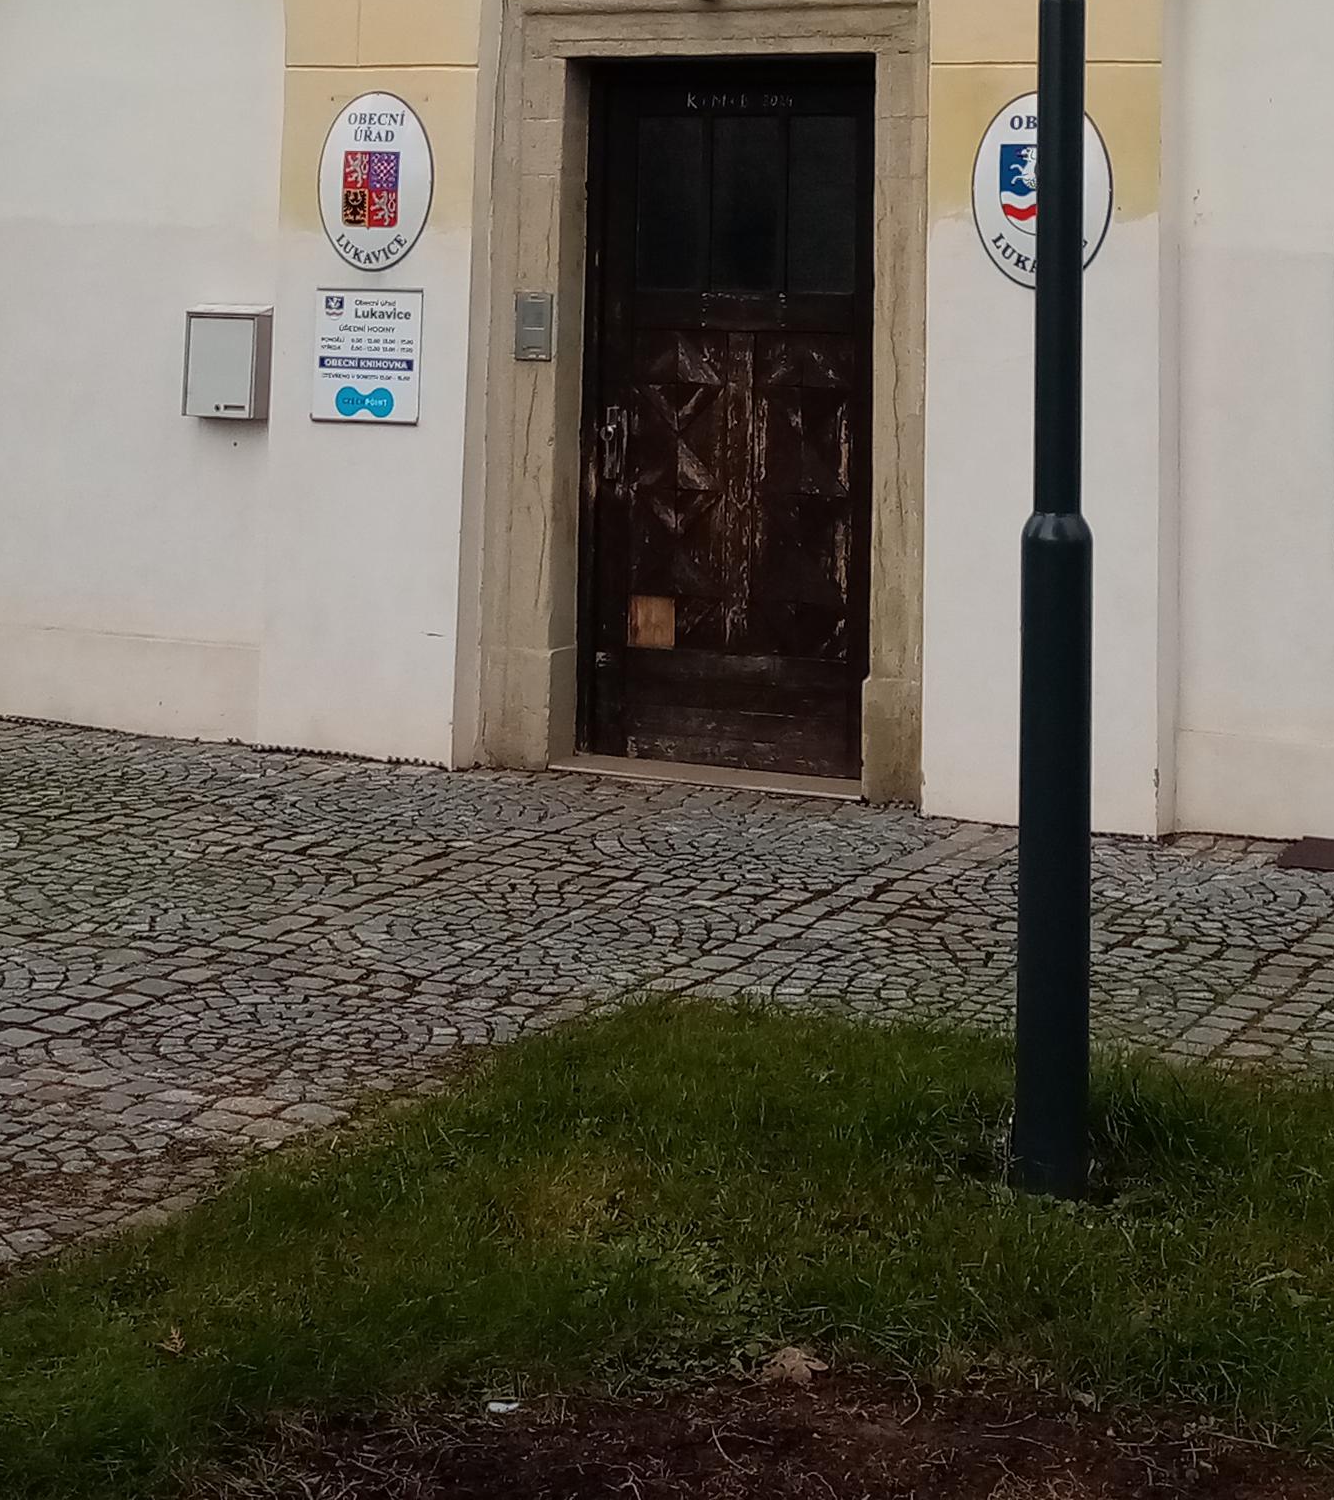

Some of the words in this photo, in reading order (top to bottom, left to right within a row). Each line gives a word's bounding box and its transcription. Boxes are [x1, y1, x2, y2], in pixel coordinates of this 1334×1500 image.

[348, 110, 405, 126] OBECNÍ
[1010, 115, 1037, 130] OB
[354, 126, 395, 142] ÚŘAD
[336, 233, 407, 264] LUKAVICE
[354, 308, 411, 320] Lukavice
[324, 357, 359, 368] OBECNÍ
[360, 359, 408, 369] KNIHOVNA
